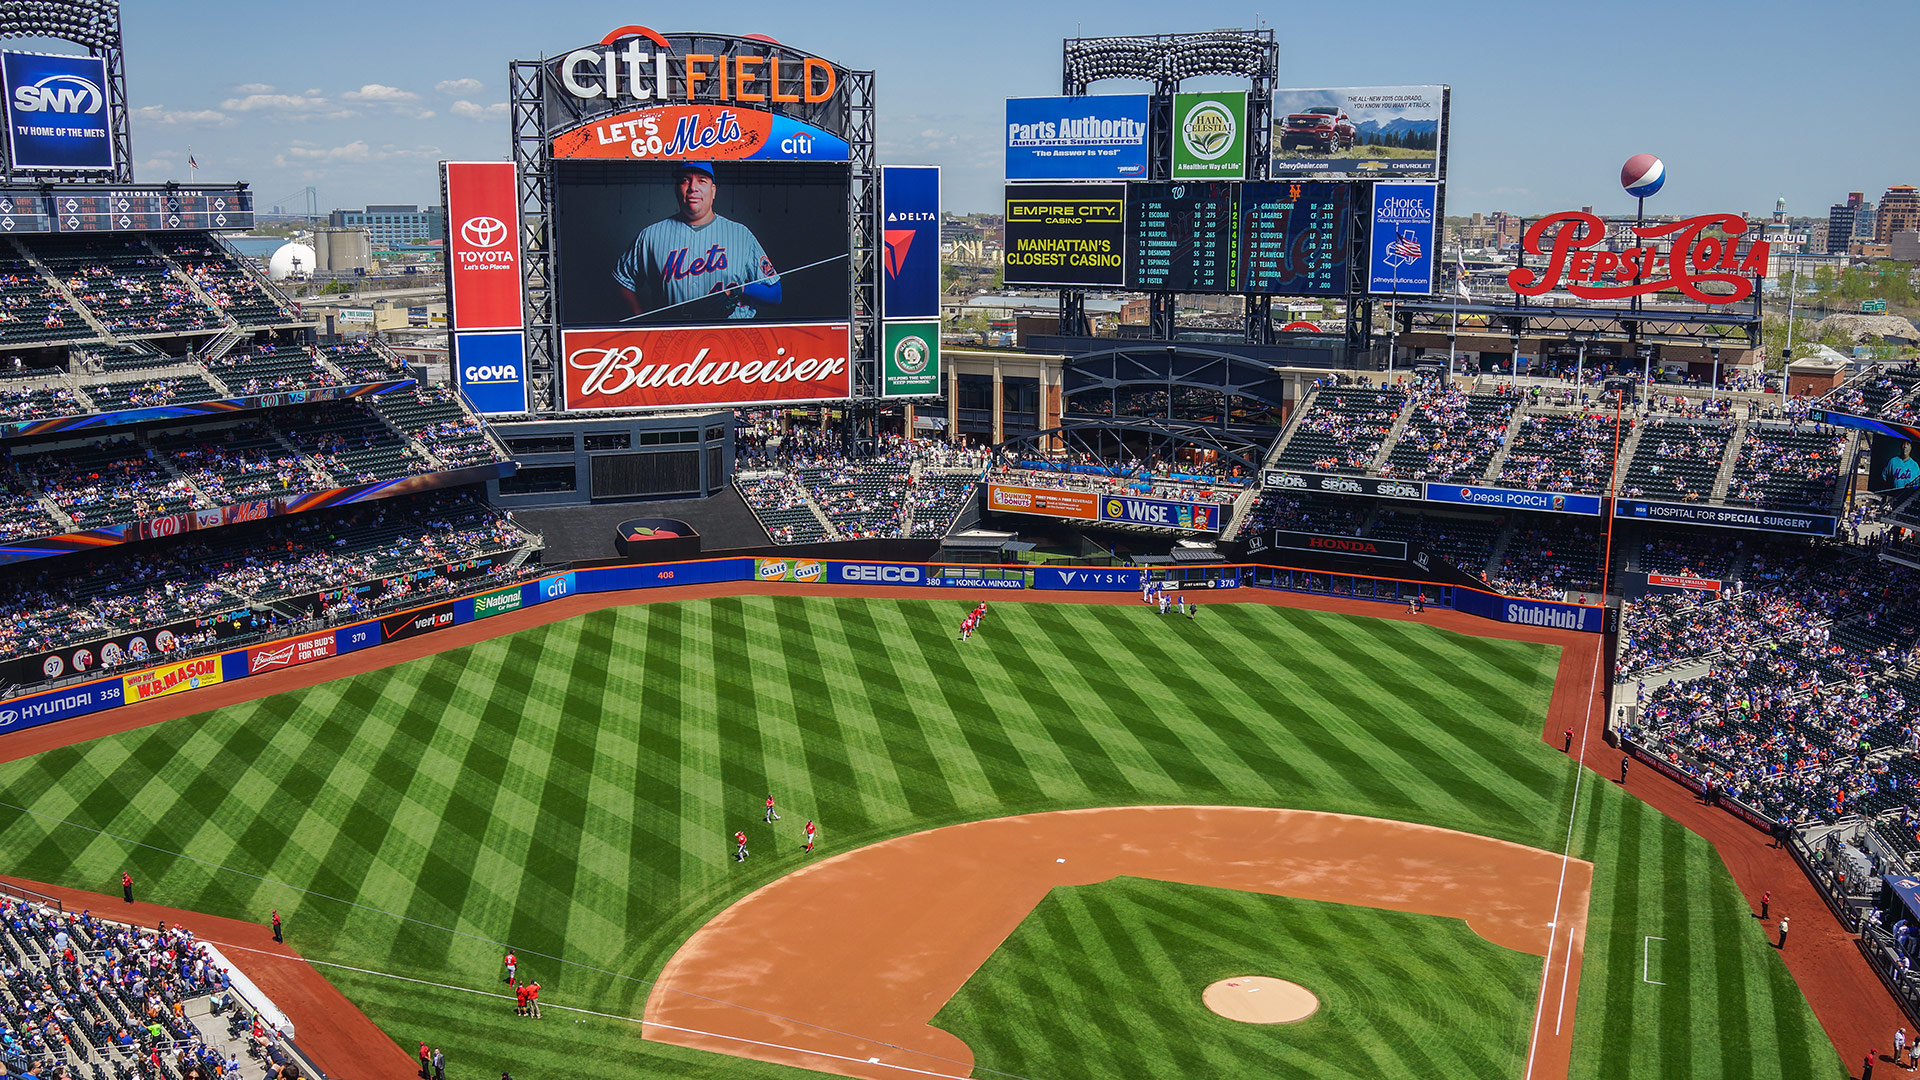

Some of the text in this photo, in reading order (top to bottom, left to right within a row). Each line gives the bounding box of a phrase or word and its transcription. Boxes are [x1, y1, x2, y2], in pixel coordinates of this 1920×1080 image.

[685, 54, 836, 103] FIELD
[14, 86, 88, 113] SNY
[1197, 116, 1223, 124] HAIN
[17, 126, 105, 138] TV HOME OF THE METS
[596, 117, 659, 145] LET'S
[1009, 115, 1146, 139] Parts Authority
[1184, 123, 1233, 133] CELESTIAL
[631, 110, 741, 157] GO Mets
[781, 135, 812, 154] citi
[1209, 163, 1220, 171] Way
[1279, 162, 1329, 171] ChevyDealer.com
[1233, 202, 1237, 210] 1
[1384, 197, 1424, 208] CHOICE
[900, 212, 936, 221] DELTA
[1013, 206, 1074, 215] EMPIRE
[1232, 212, 1238, 220] 2
[1377, 208, 1431, 217] SOLUTIONS
[1232, 222, 1237, 230] 3
[1017, 239, 1111, 252] MANHATTAN'S
[1232, 240, 1236, 248] 5
[458, 251, 514, 263] TOYOTA
[1006, 253, 1121, 267] CLOSEST CASINO
[1232, 250, 1236, 258] 6
[662, 244, 728, 283] Mets
[1230, 270, 1236, 278] 8
[1230, 279, 1236, 287] 9
[465, 365, 516, 381] GOYA
[569, 346, 845, 396] Budweiser
[1004, 492, 1032, 500] DUNKIN'
[1473, 492, 1547, 507] pepsi PORCH
[1004, 499, 1031, 507] DONUTS
[232, 501, 268, 524] Mets
[1127, 500, 1168, 522] WISE
[1650, 506, 1695, 519] HOSPITAL
[1697, 510, 1716, 520] FOR
[1718, 512, 1761, 524] SPECIAL
[1763, 516, 1812, 529] SURGERY
[1309, 537, 1378, 553] HONDA
[657, 570, 674, 580] 408
[761, 564, 785, 576] Gulf
[795, 566, 819, 577] Gulf
[842, 565, 920, 583] GEICO
[926, 578, 940, 586] 380
[988, 580, 1021, 588] MINOLTA
[1080, 574, 1127, 584] VYSK
[1220, 580, 1235, 588] 370
[548, 581, 566, 597] citi
[486, 590, 521, 608] National
[415, 611, 453, 629] verizon
[1508, 604, 1587, 630] StubHub!
[298, 636, 334, 651] THIS BUD'S
[352, 632, 366, 643] 370
[298, 650, 312, 660] FOR
[48, 662, 59, 672] 37
[127, 672, 156, 686] WHO BUT
[100, 688, 120, 700] 358
[21, 693, 92, 720] HYUNDAI
[1726, 800, 1744, 816] TOYOTA
[1752, 816, 1771, 832] TOYOTA
